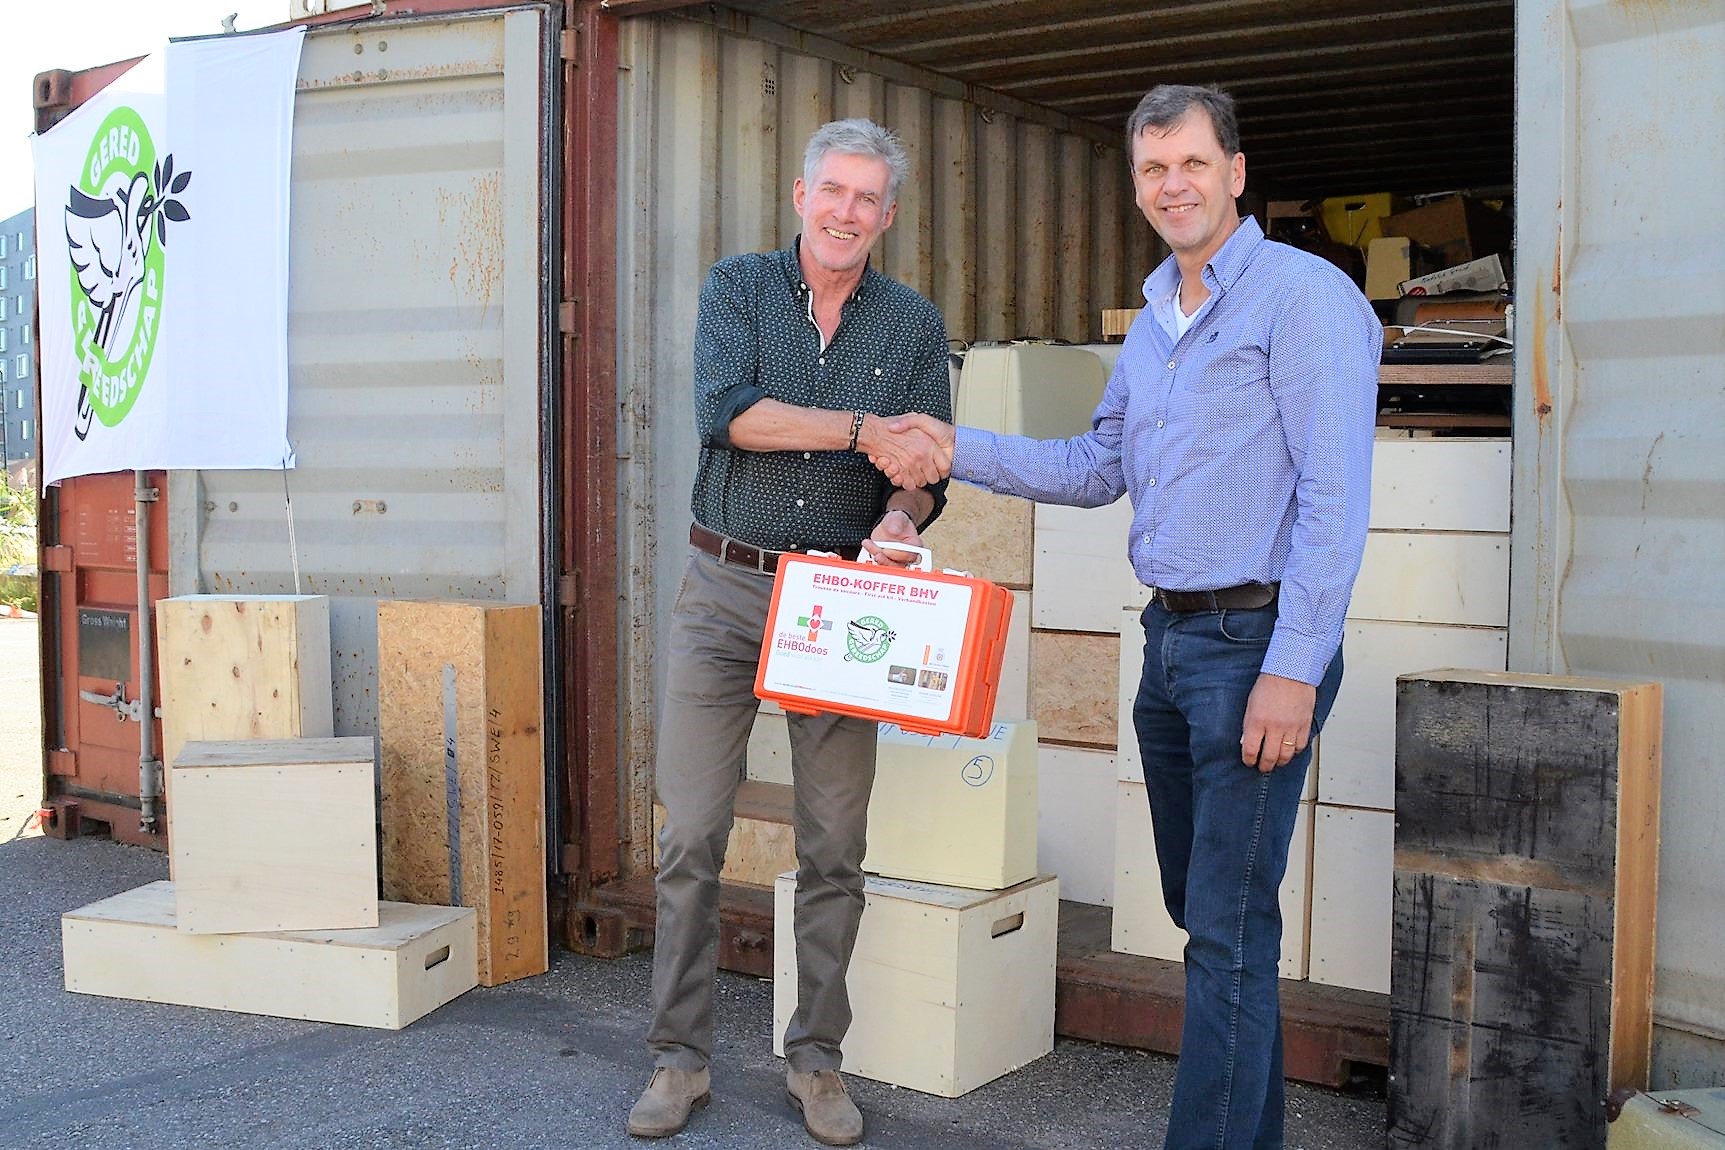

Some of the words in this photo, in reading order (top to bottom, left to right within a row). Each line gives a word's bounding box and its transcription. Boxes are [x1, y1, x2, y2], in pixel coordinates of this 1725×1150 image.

[90, 124, 140, 188] GERED
[813, 573, 906, 596] EHBO-KOFFER
[910, 586, 939, 600] BHV
[81, 613, 102, 626] Gross
[860, 617, 884, 628] GERED
[788, 632, 806, 641] beste
[777, 639, 828, 656] EHBOdoos
